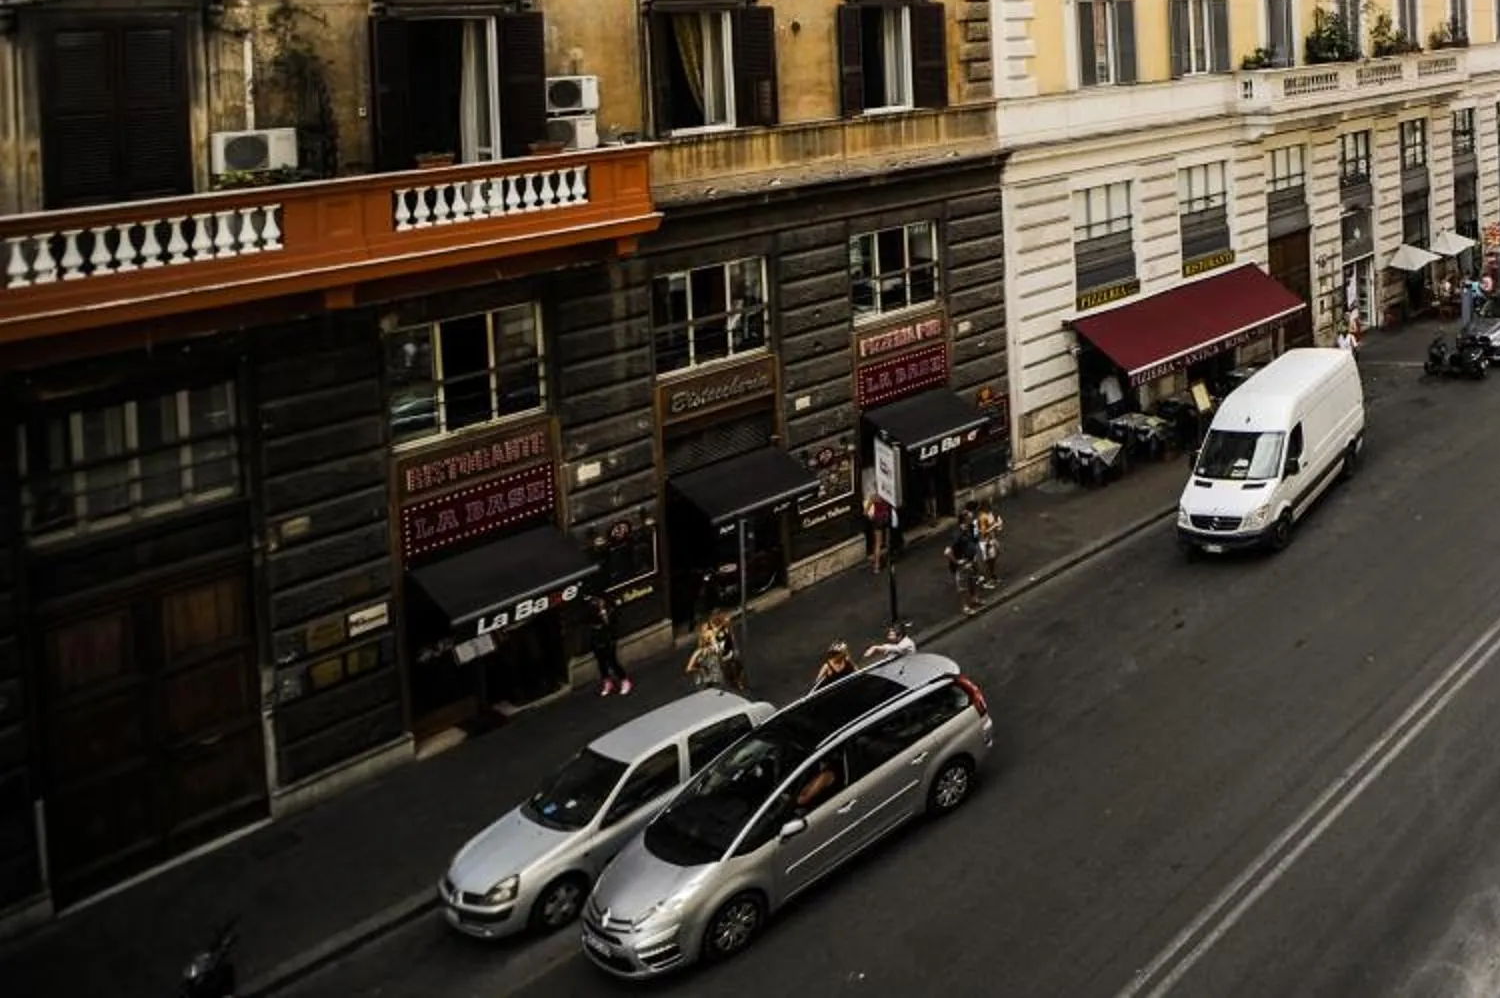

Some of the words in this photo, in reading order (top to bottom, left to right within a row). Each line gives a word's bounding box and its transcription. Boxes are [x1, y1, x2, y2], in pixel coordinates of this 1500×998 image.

[941, 428, 980, 453] Bae
[414, 508, 460, 540] LA
[465, 480, 546, 523] BASE
[476, 612, 509, 636] La
